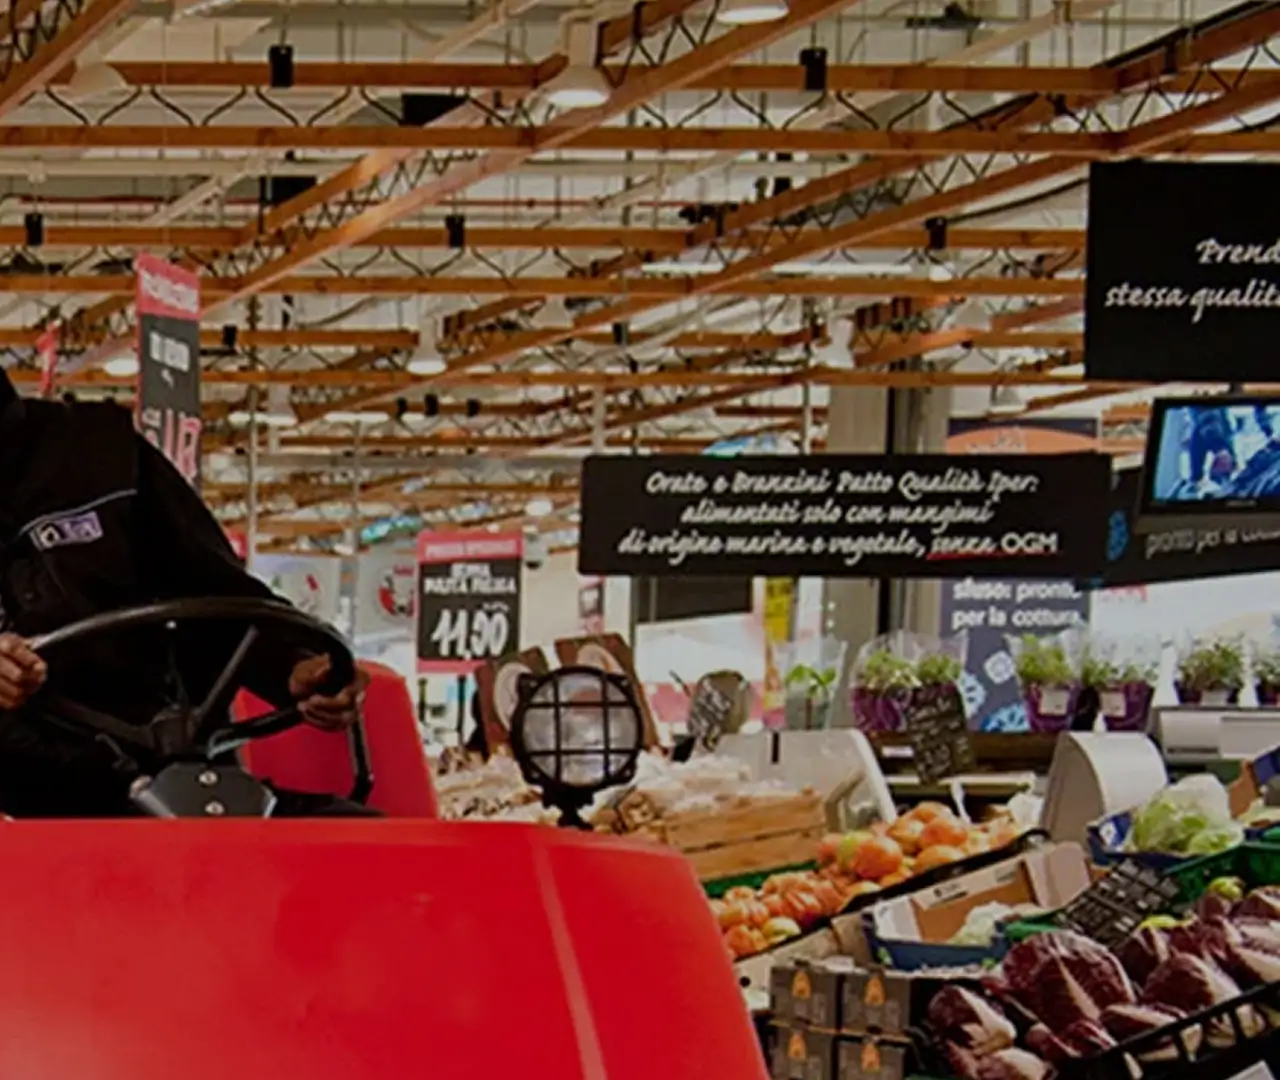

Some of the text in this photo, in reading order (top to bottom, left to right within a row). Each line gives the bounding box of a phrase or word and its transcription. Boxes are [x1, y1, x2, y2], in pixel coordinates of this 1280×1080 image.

[1104, 282, 1189, 309] stessa
[645, 470, 708, 495] Orate
[712, 475, 729, 495] e
[731, 467, 831, 495] Branzini
[836, 470, 894, 493] Patto
[898, 467, 986, 502] Qualità
[680, 497, 994, 535] alimentati solo con mangimi
[618, 527, 647, 554] di
[647, 528, 724, 566] origine
[811, 536, 827, 555] e
[930, 535, 997, 555] senza
[1001, 531, 1059, 554] OGM
[951, 609, 985, 631] per
[988, 605, 1007, 627] la
